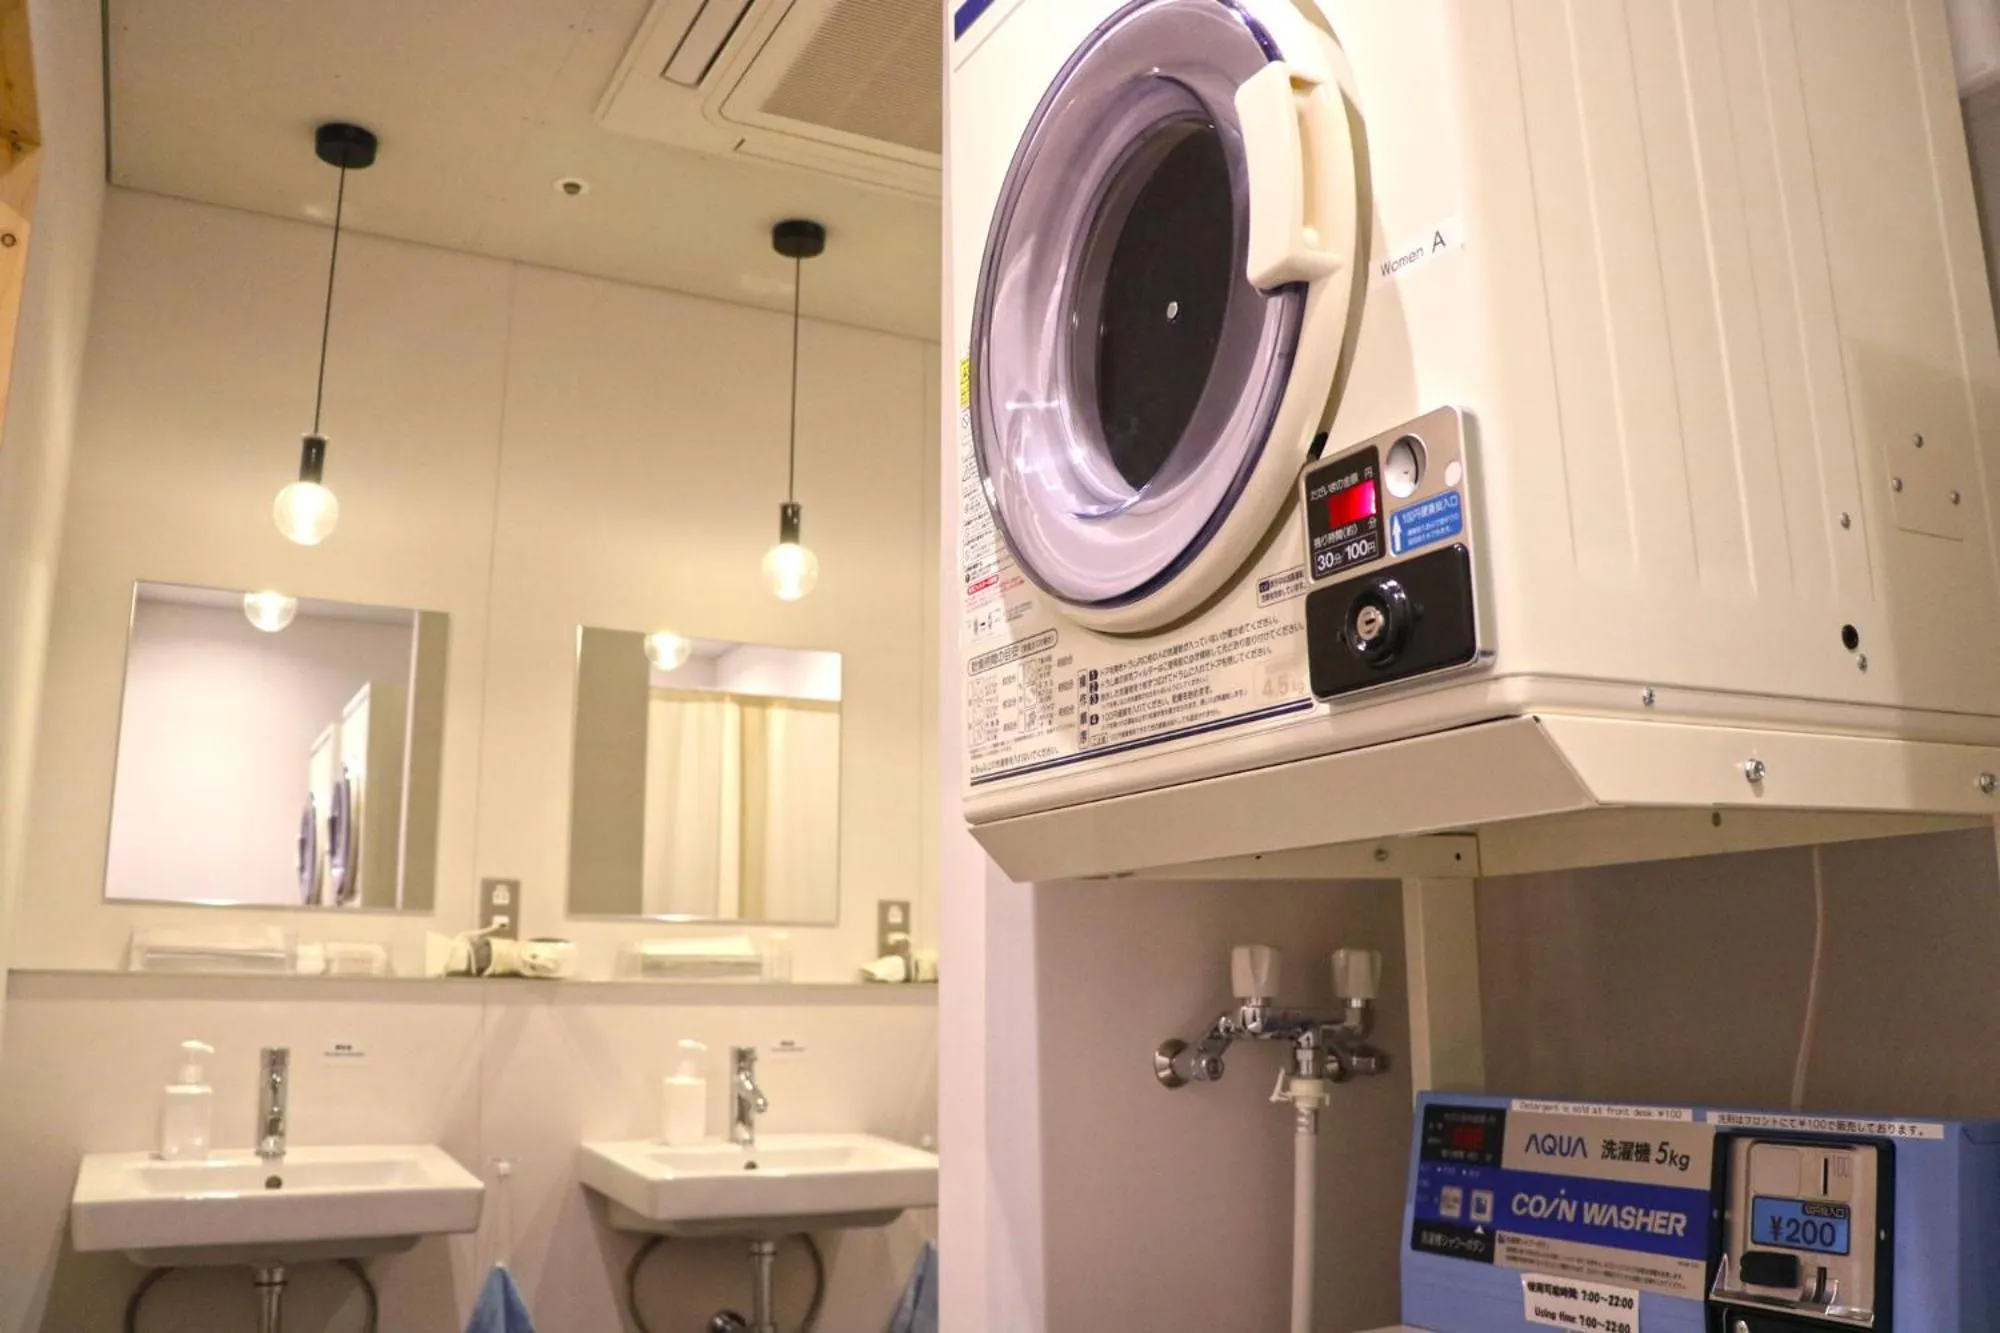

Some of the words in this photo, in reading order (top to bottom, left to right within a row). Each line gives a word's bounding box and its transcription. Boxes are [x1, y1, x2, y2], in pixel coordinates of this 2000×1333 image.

[1381, 247, 1424, 276] Women
[1432, 230, 1446, 254] A
[1525, 1133, 1588, 1159] AQUA
[1600, 1138, 1651, 1164] 洗濯機
[1655, 1141, 1691, 1172] 5kg
[1583, 1200, 1688, 1237] WASHER
[1769, 1215, 1837, 1247] ¥200
[1534, 1305, 1557, 1321] Using
